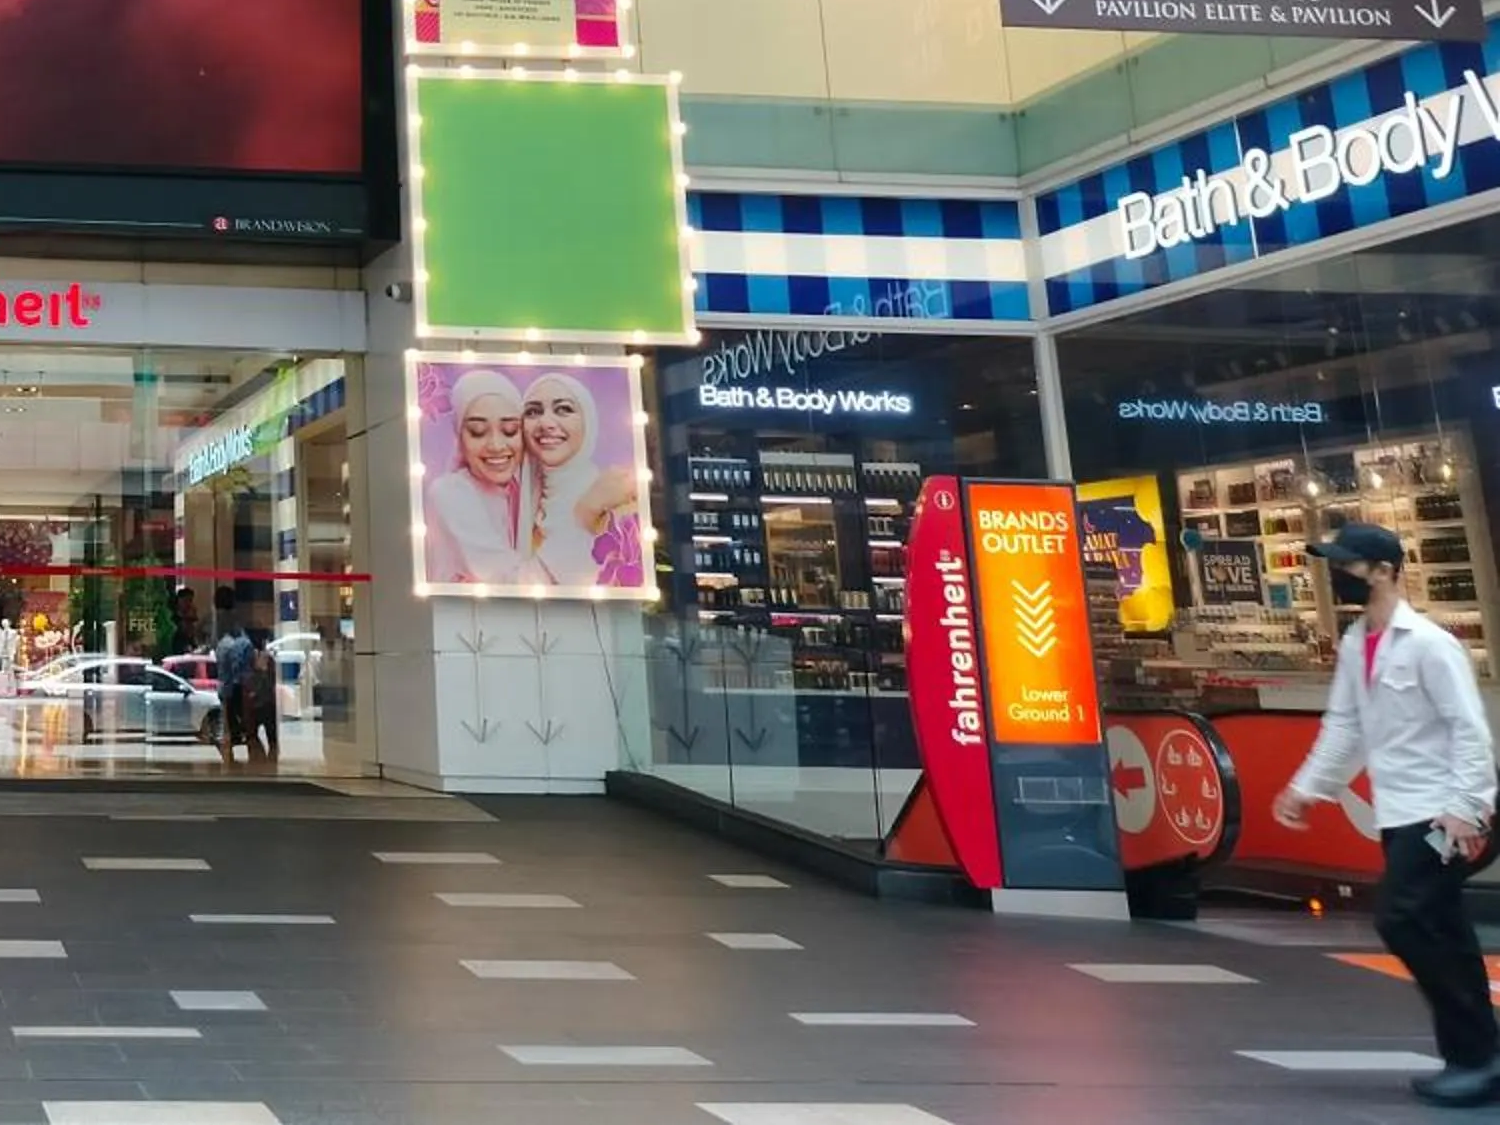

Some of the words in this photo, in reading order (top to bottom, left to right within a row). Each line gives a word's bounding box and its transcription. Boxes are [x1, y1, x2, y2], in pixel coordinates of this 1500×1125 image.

[1095, 0, 1195, 20] PAVILION
[1205, 3, 1262, 22] ELITE
[1269, 6, 1287, 23] &
[1292, 6, 1392, 26] PAVILION
[1117, 168, 1238, 261] Bath
[1243, 147, 1291, 219] &
[1288, 90, 1464, 205] Body
[699, 386, 755, 408] Bath
[756, 387, 775, 409] &
[776, 388, 836, 415] Body
[839, 391, 912, 413] Works
[978, 509, 1069, 532] BRANDS
[981, 534, 1068, 554] OUTLET
[935, 556, 981, 746] fahrenheit
[1021, 685, 1069, 702] Lower
[1008, 705, 1071, 721] Ground
[1077, 705, 1085, 721] 1
